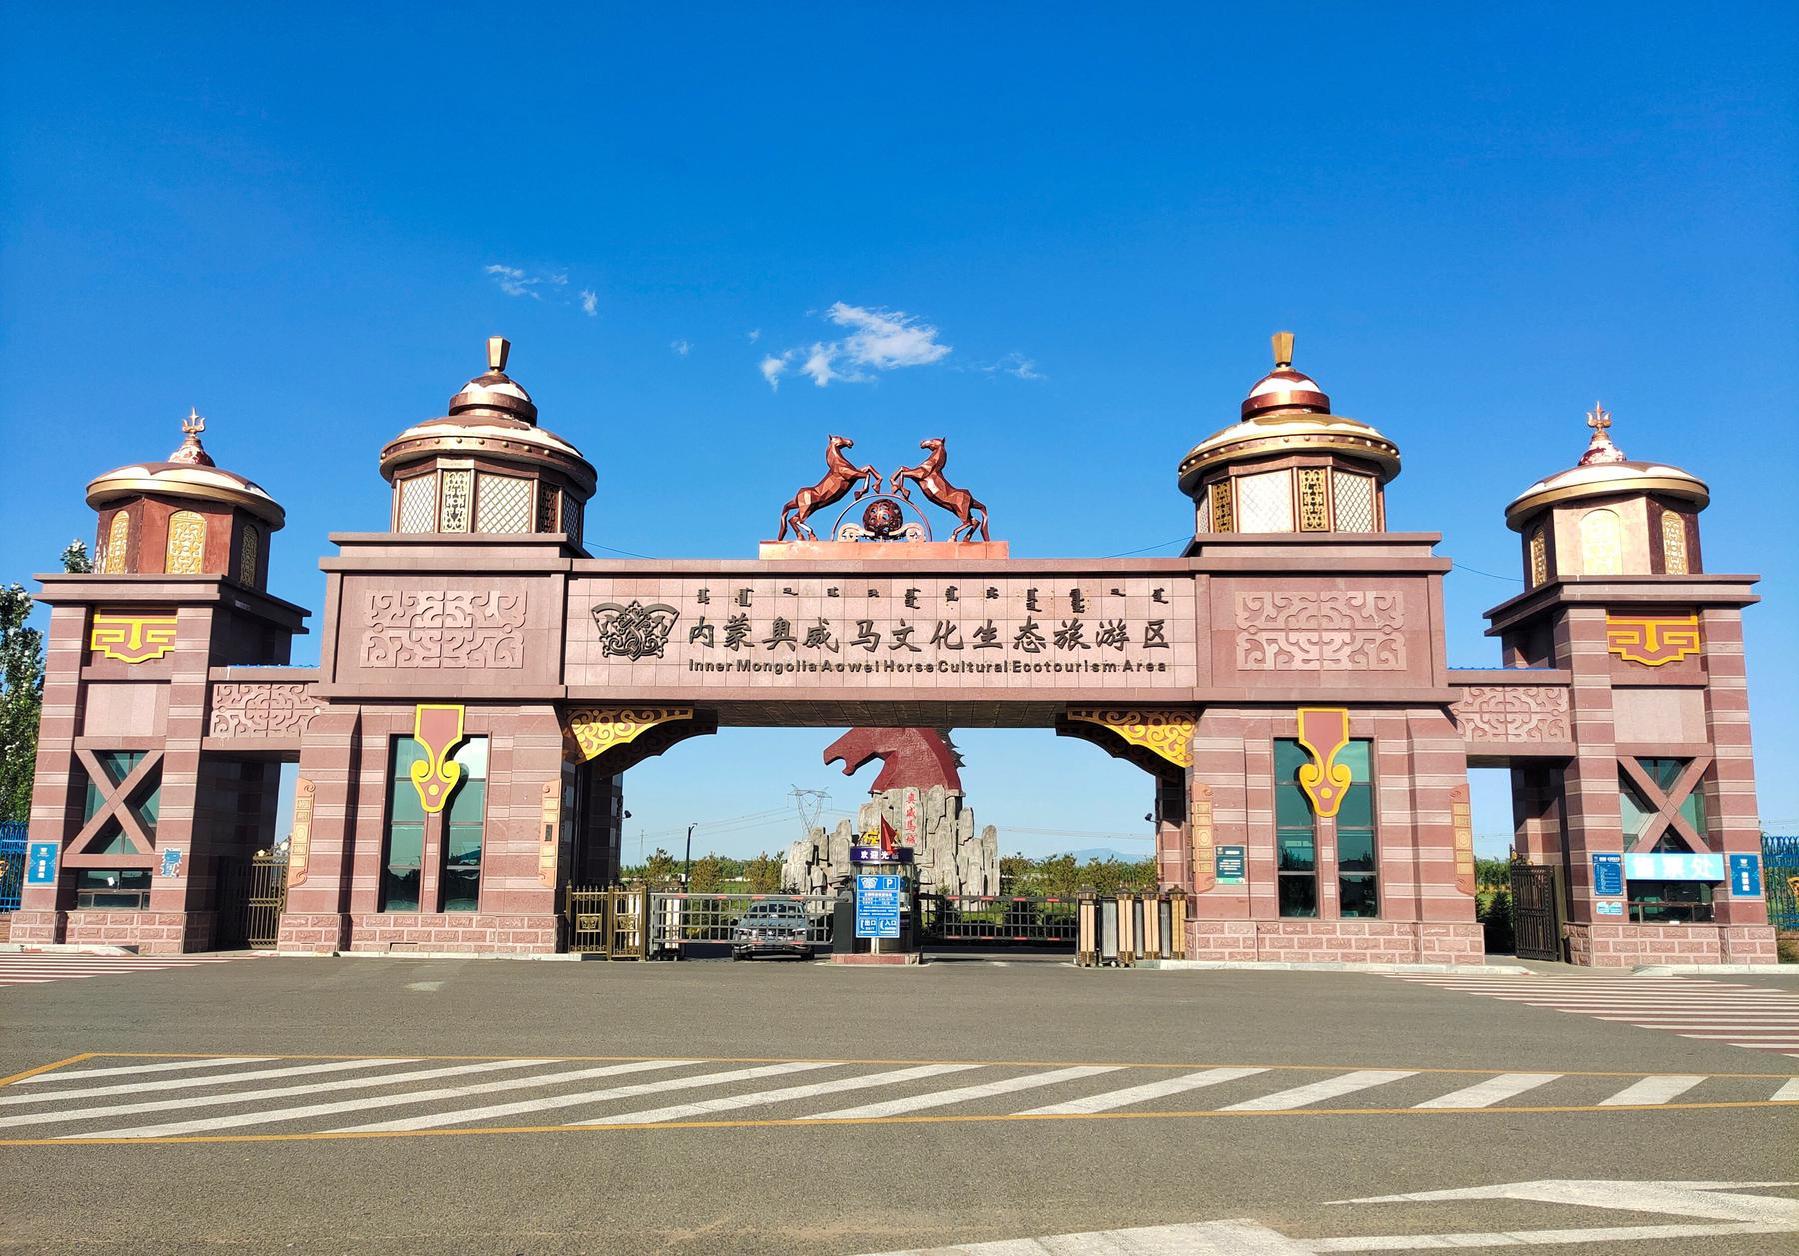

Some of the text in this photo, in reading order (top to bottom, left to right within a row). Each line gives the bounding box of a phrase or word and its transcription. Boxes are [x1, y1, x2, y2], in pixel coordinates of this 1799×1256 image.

[689, 612, 1170, 654] 内蒙奥威马文化生态旅游区
[689, 658, 1166, 676] Inner Mongolia Aowei Horse Cultural Ecotourism Area
